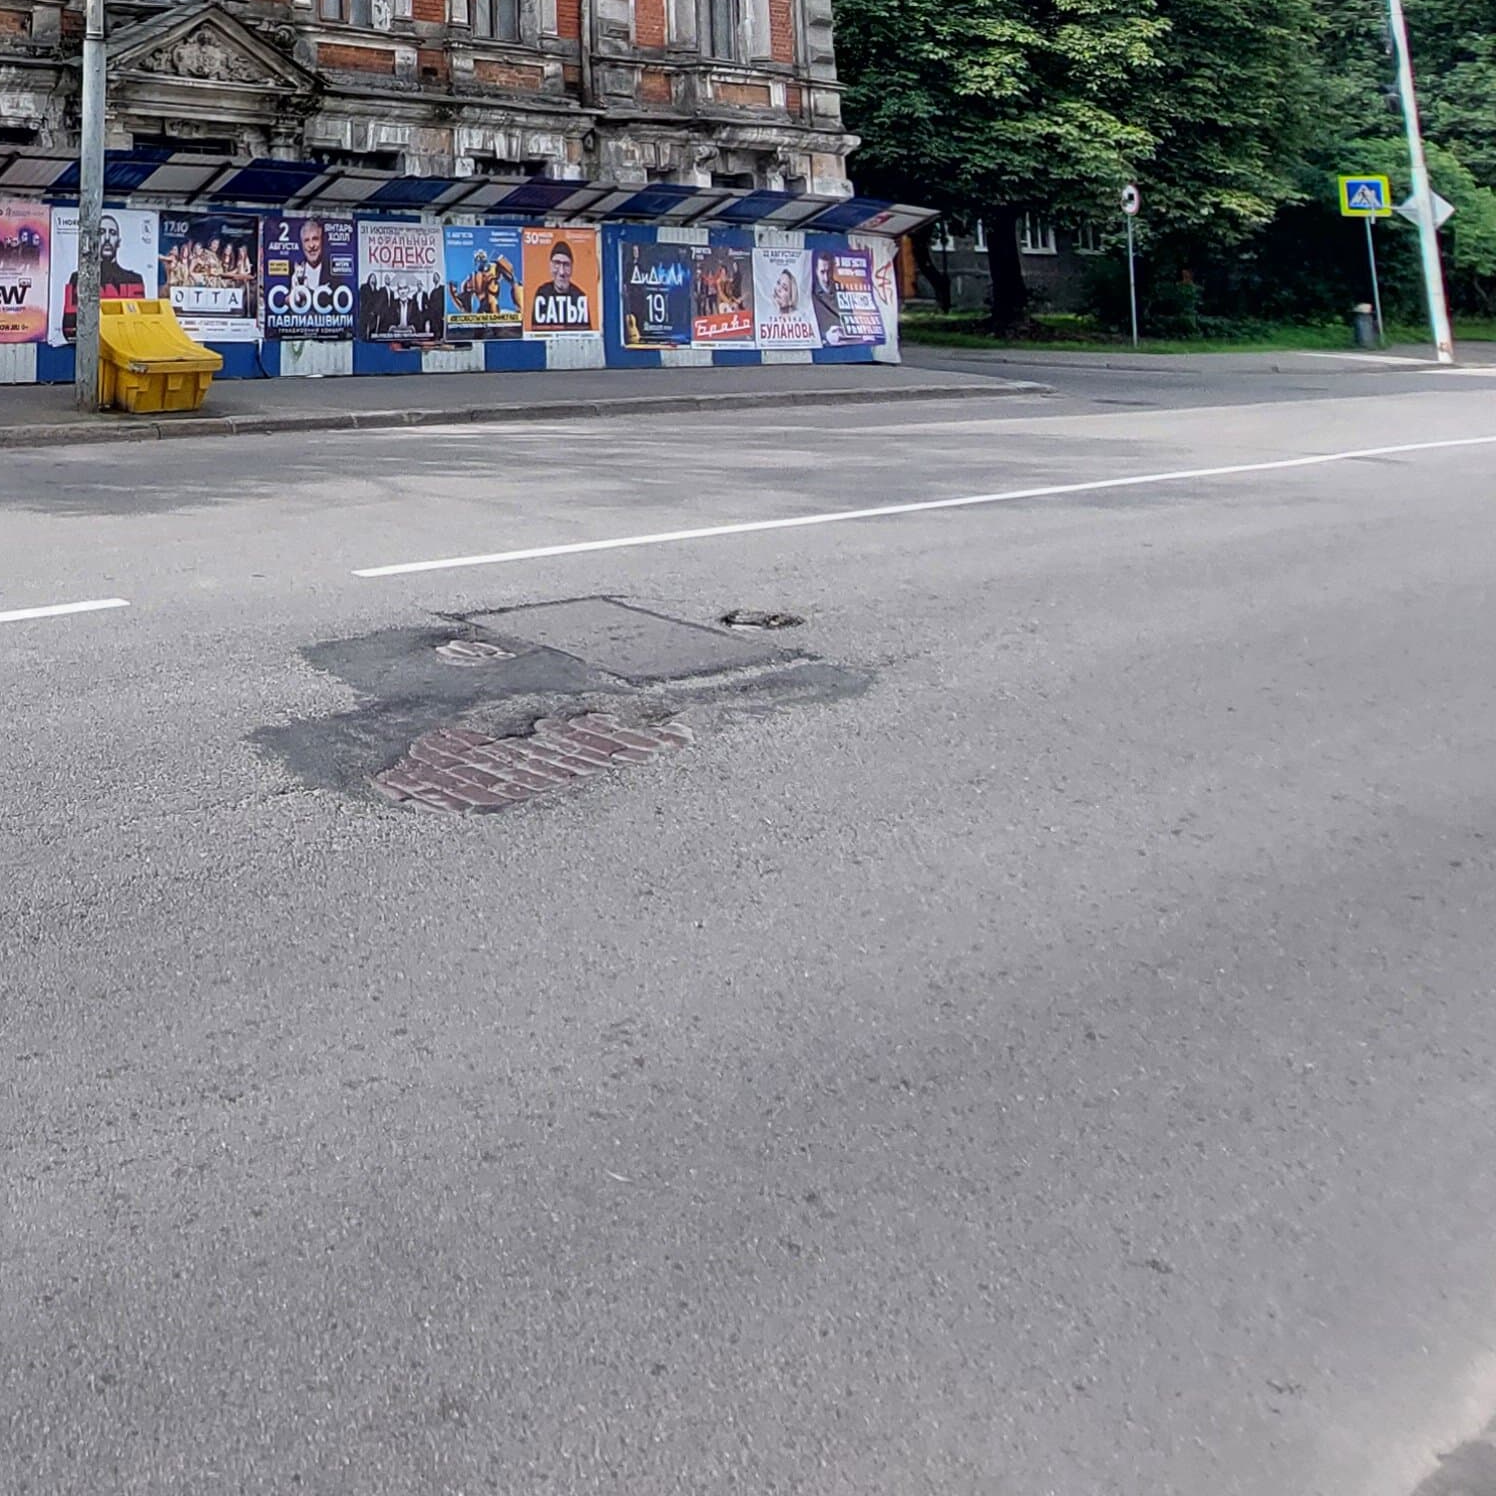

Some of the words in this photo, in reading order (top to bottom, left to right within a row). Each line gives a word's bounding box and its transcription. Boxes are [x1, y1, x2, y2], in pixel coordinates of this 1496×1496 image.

[278, 222, 289, 242] 2
[368, 236, 436, 246] МОРАЛЬНЫЙ
[524, 232, 539, 245] 30
[268, 242, 299, 250] АВГУСТА
[368, 246, 436, 268] КОДЕКС
[268, 285, 353, 315] СОСО
[534, 295, 589, 324] САТЬЯ
[646, 293, 665, 323] 19
[267, 315, 353, 328] ПАВЛИАШВИЛИ
[694, 314, 751, 337] Браво
[760, 324, 815, 339] БУЛАНОВА
